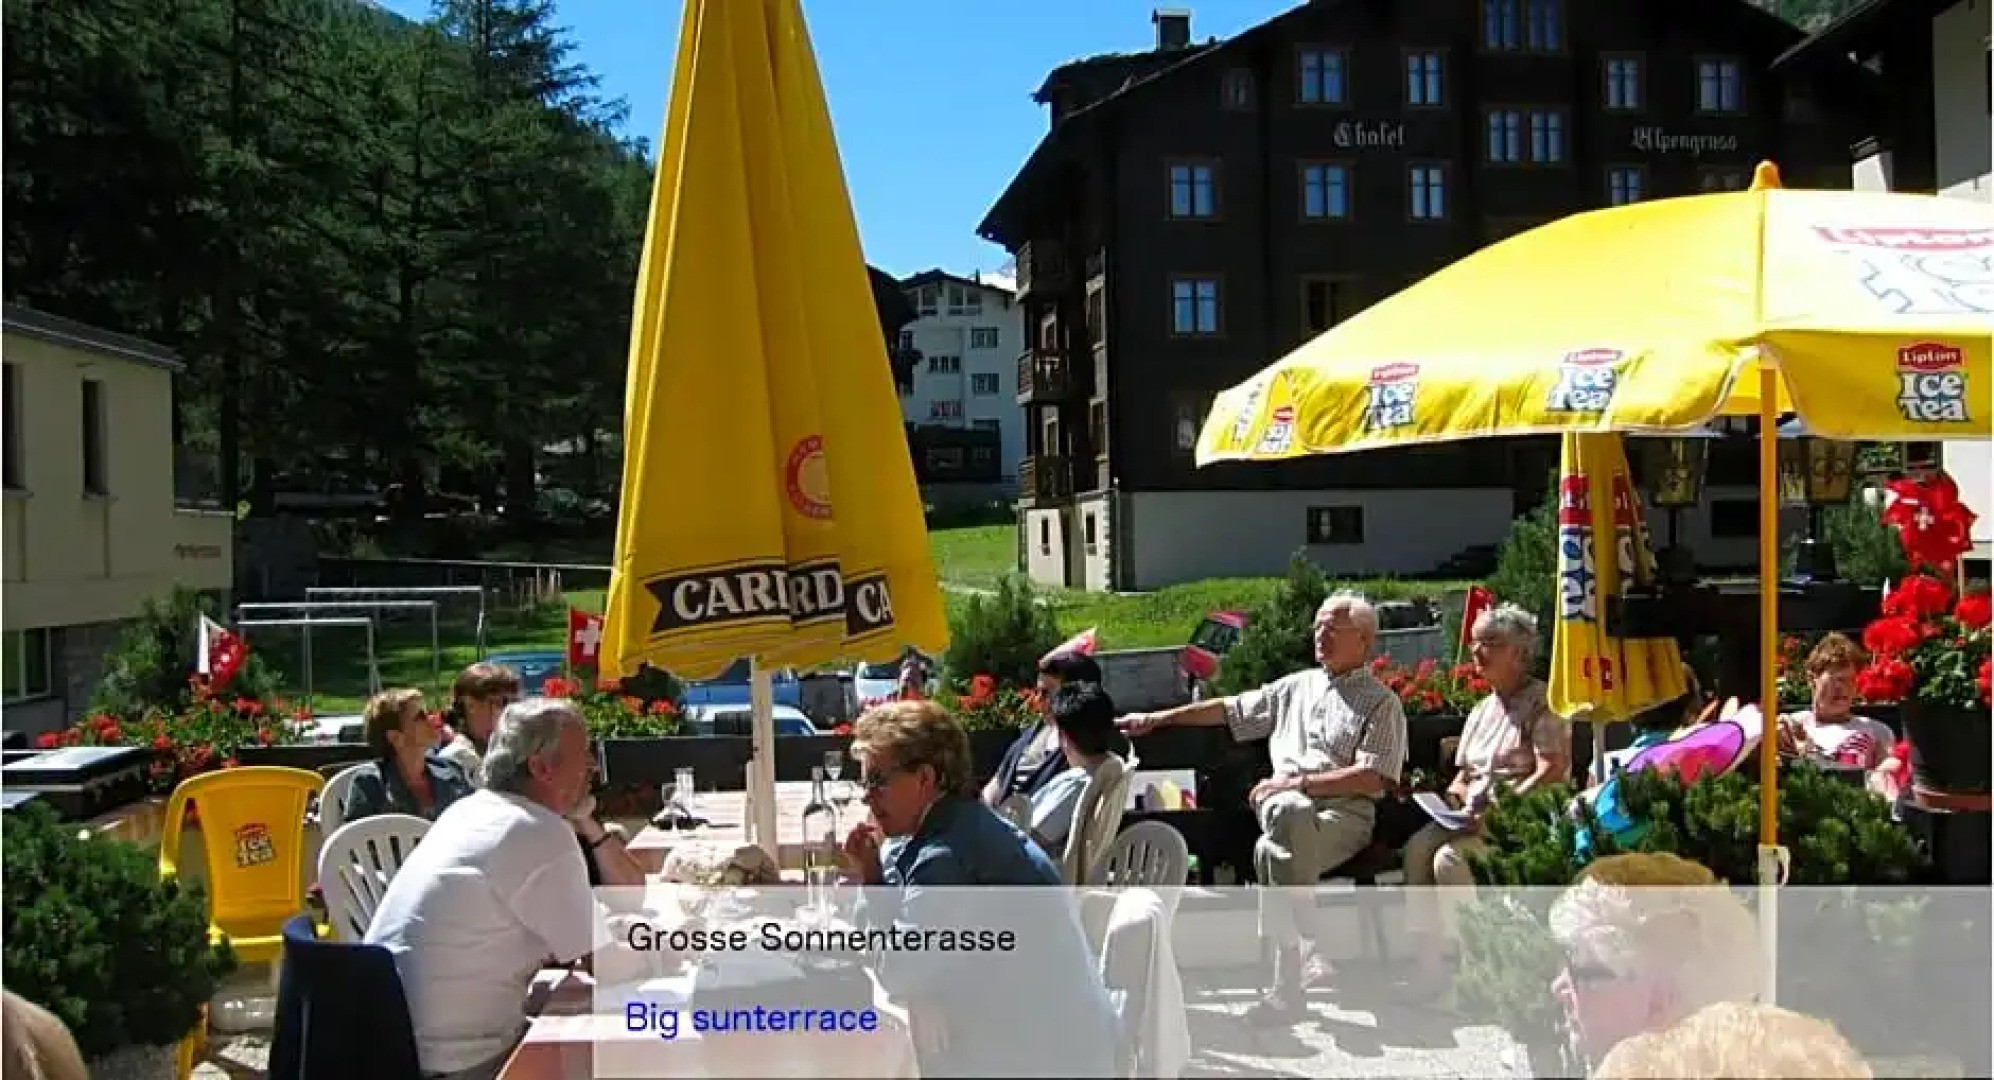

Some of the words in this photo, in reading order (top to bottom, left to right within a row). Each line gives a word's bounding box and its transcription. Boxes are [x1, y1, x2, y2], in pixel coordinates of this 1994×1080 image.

[1903, 349, 1958, 364] Lipton
[1900, 372, 1964, 398] Ice
[1897, 398, 1967, 420] Tea
